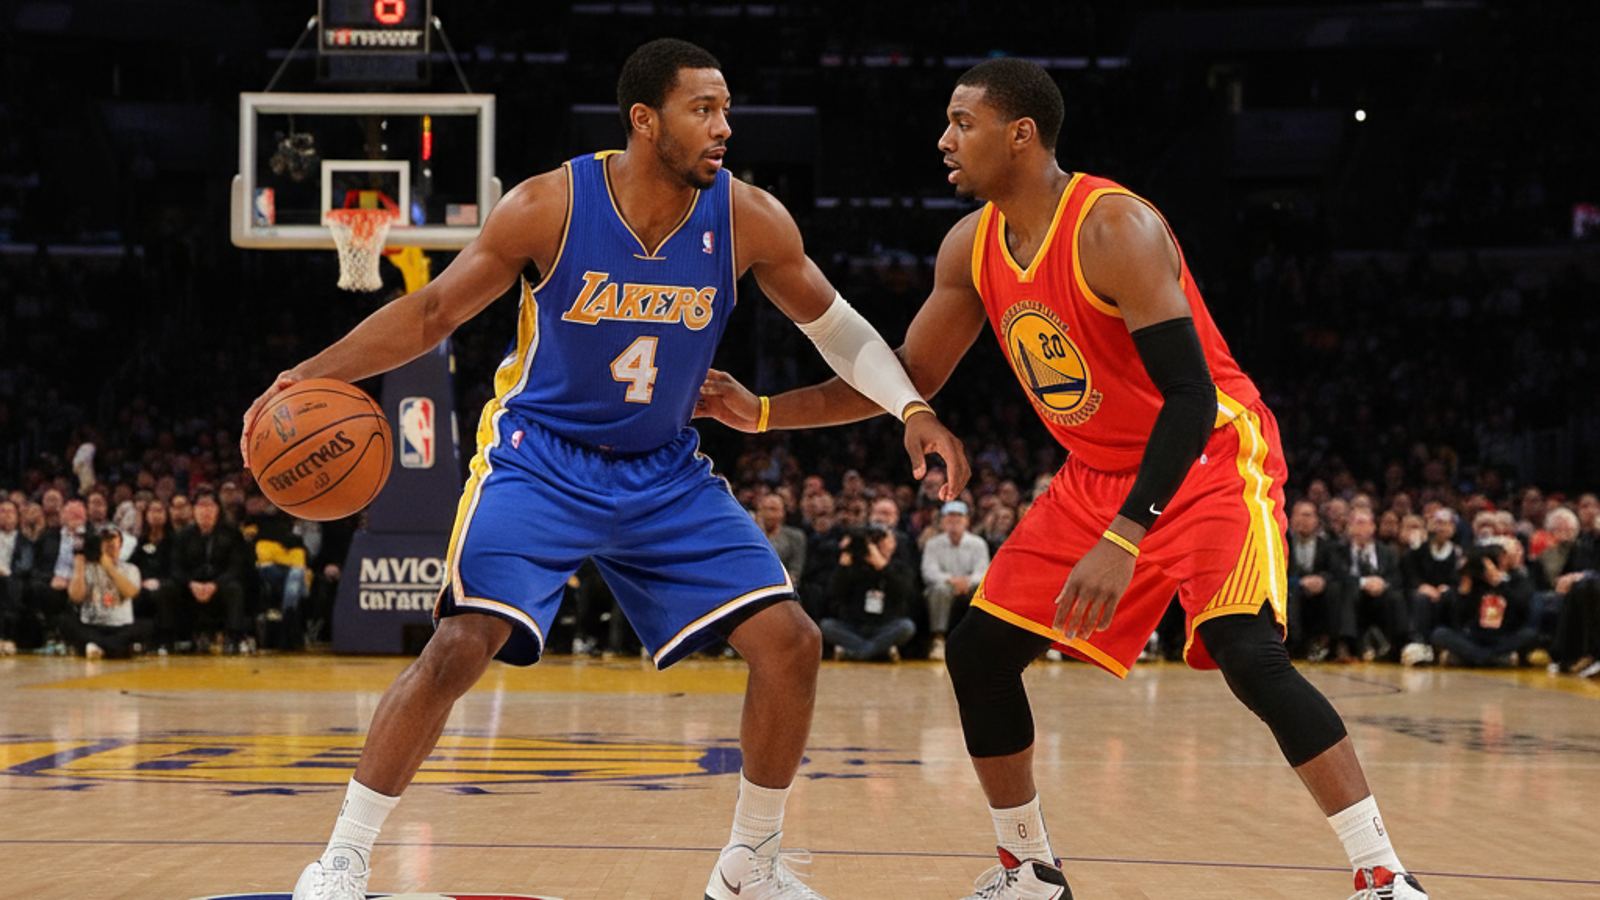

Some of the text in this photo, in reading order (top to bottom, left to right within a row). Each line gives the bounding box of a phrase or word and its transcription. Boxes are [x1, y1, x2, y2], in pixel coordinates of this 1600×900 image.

[561, 271, 717, 331] LAKERS
[610, 336, 659, 404] 4
[360, 557, 447, 584] MVIO
